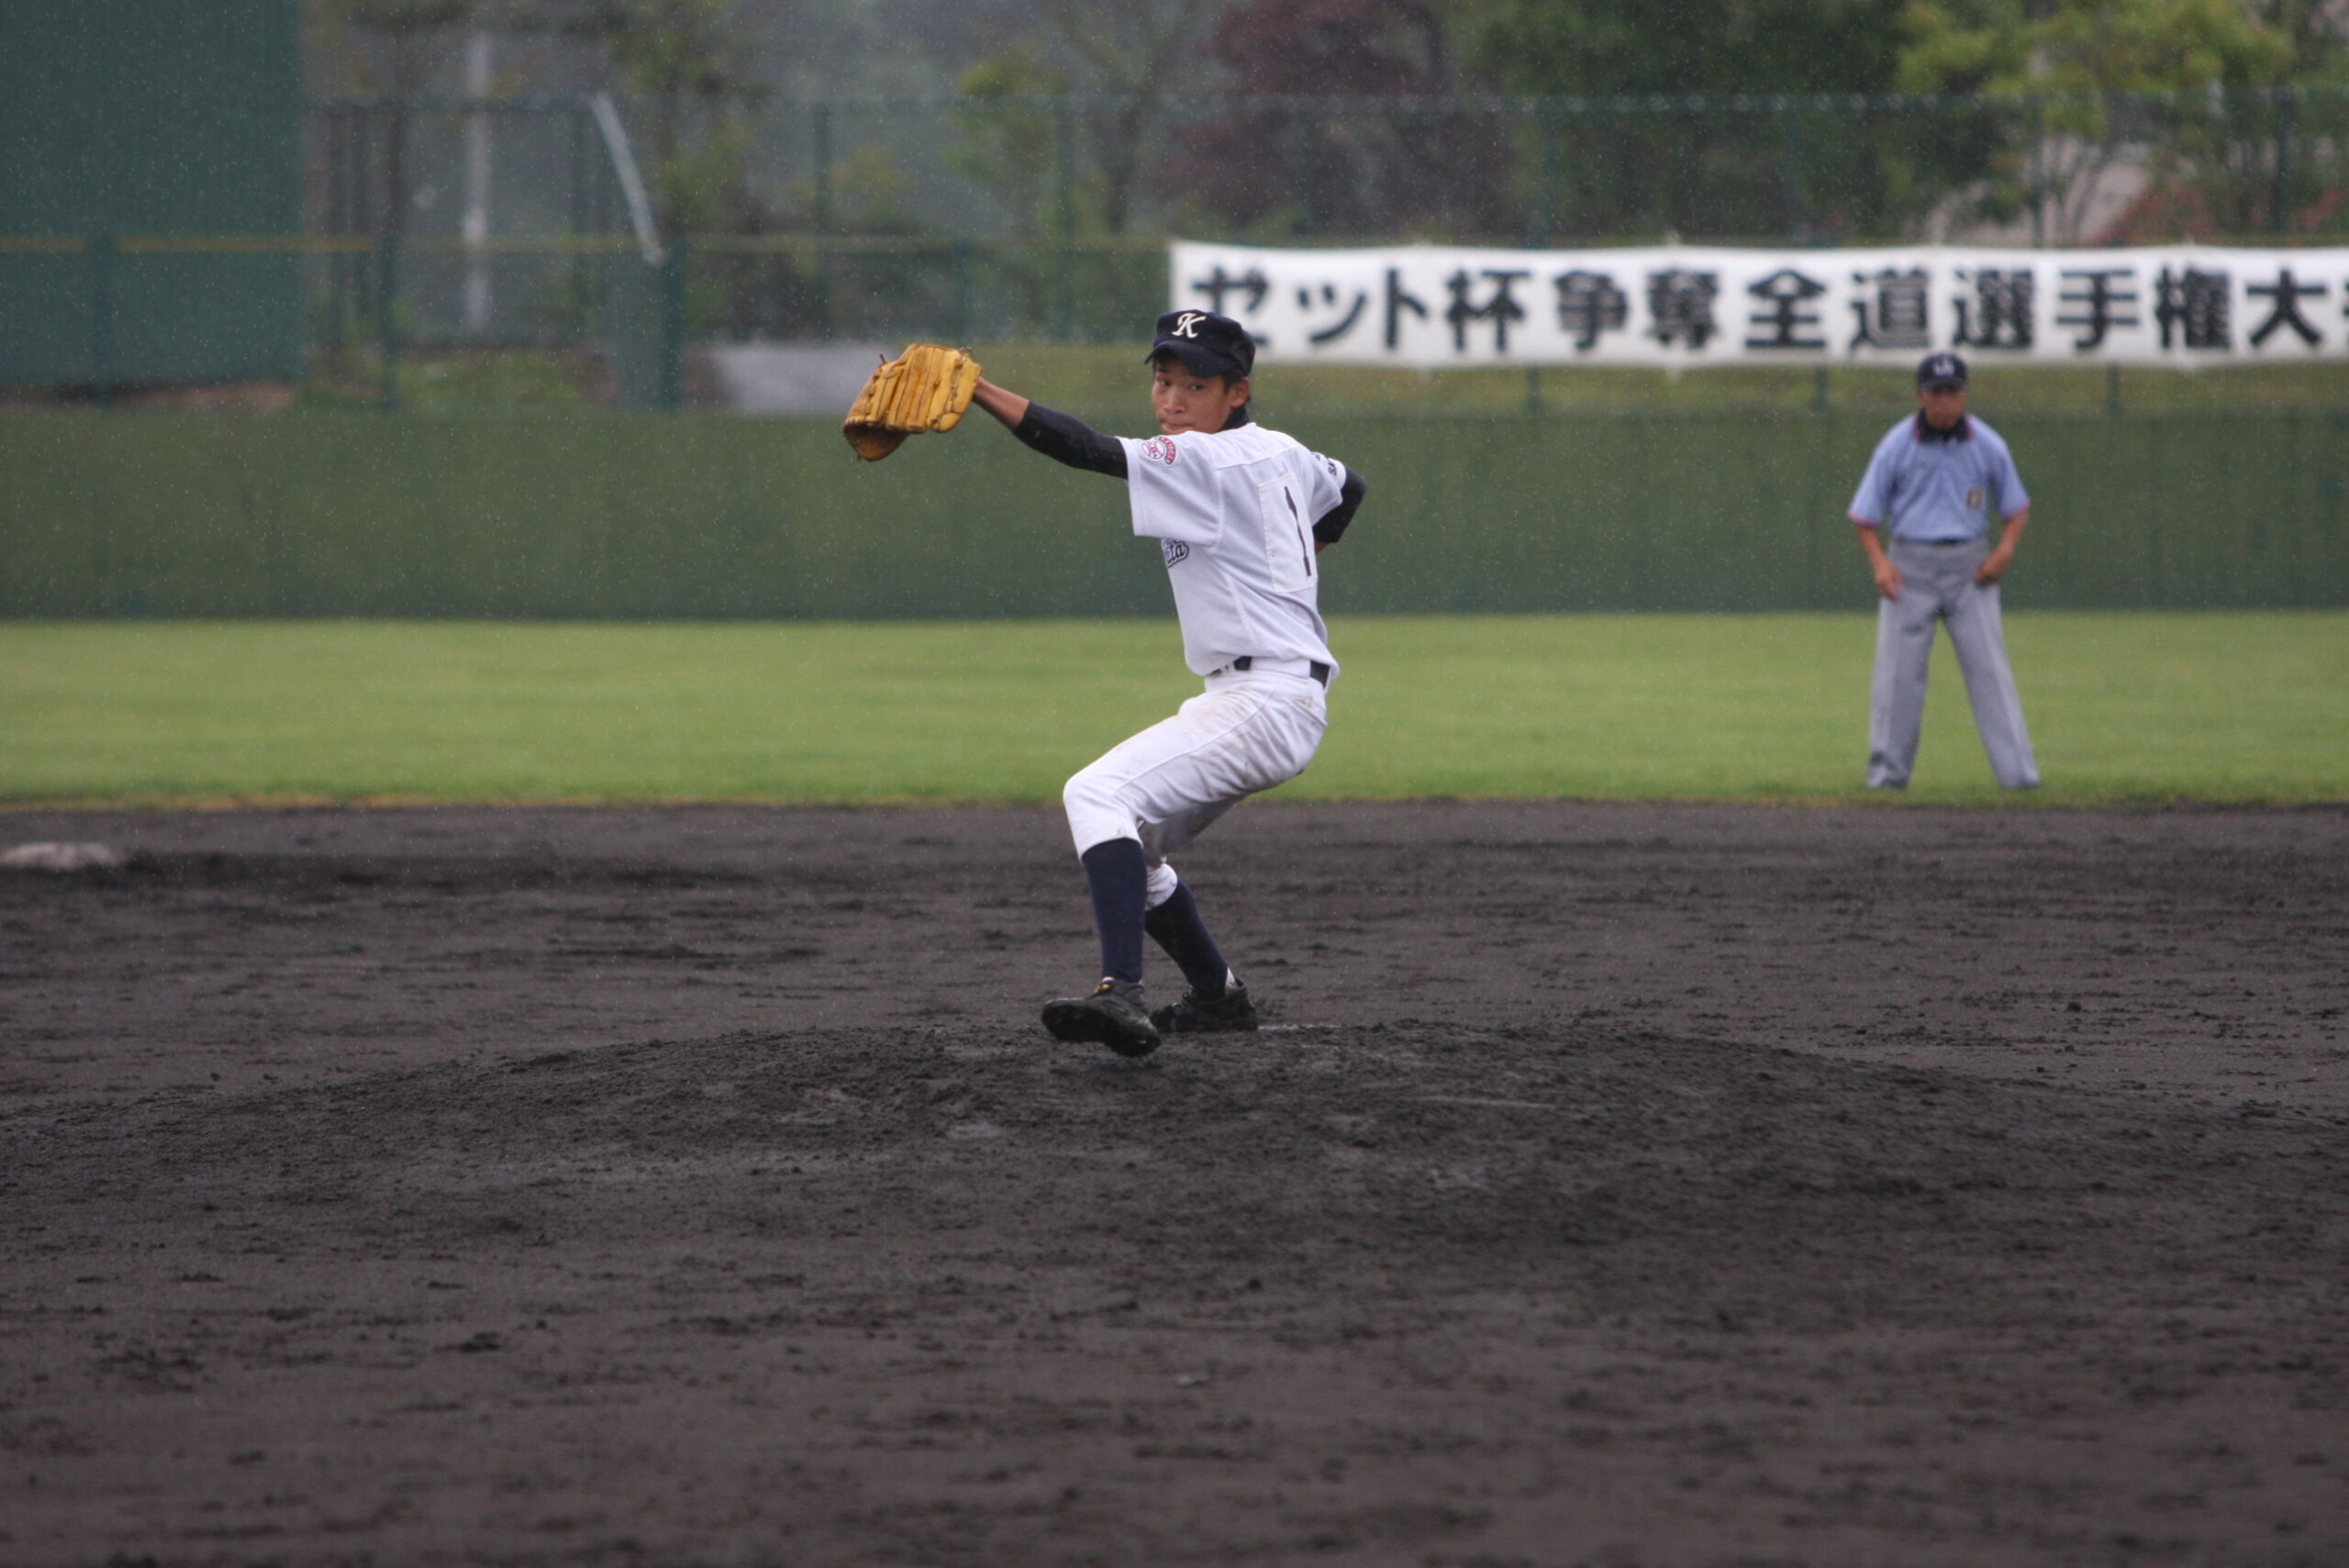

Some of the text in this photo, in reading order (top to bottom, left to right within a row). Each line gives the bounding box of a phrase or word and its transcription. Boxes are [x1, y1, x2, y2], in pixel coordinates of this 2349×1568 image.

[1172, 312, 1208, 339] K
[1192, 264, 2349, 352] ゼット杯争奪全道選手権大
[1284, 485, 1311, 577] 1
